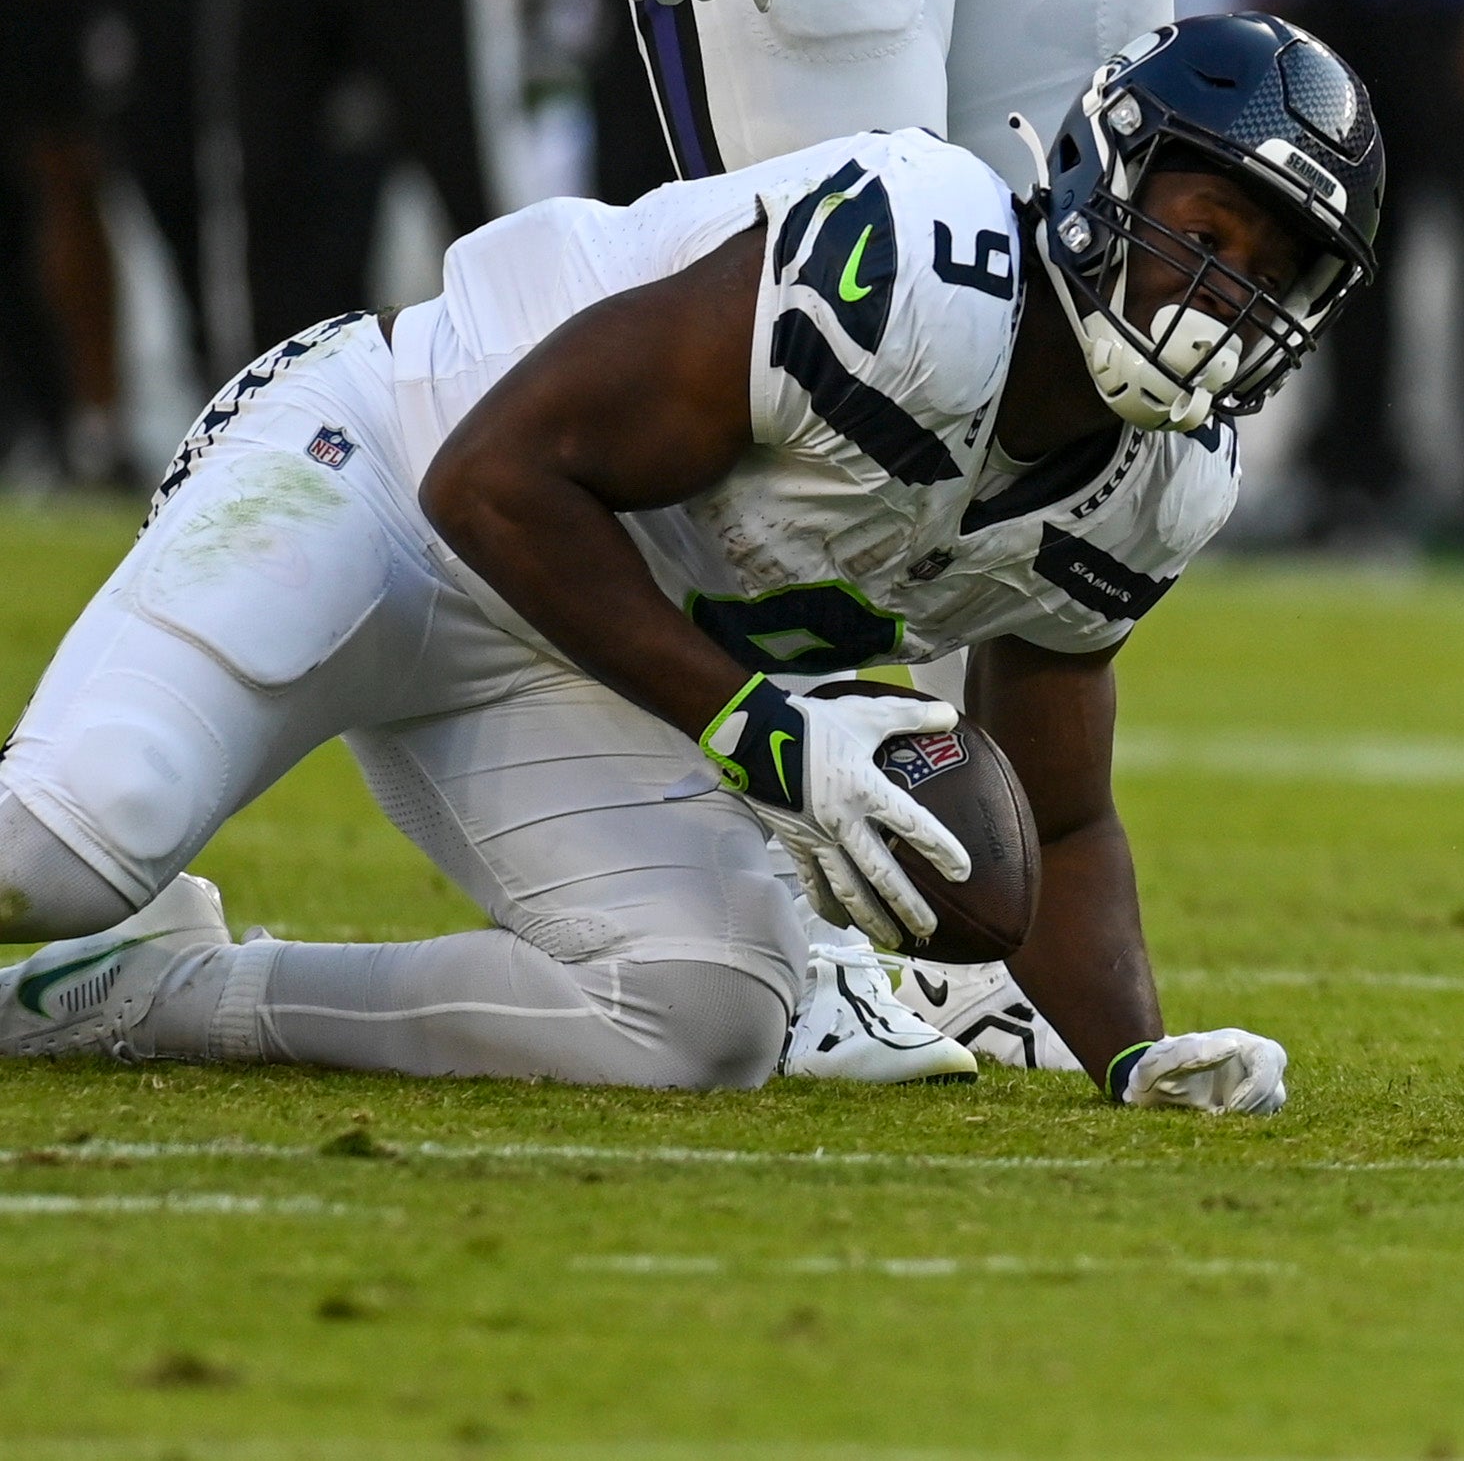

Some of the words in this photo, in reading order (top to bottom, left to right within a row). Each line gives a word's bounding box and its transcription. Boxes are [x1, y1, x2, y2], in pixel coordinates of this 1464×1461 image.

[1284, 151, 1337, 200] SEAHAWKS
[310, 439, 341, 464] NFL
[910, 734, 961, 767] NF
